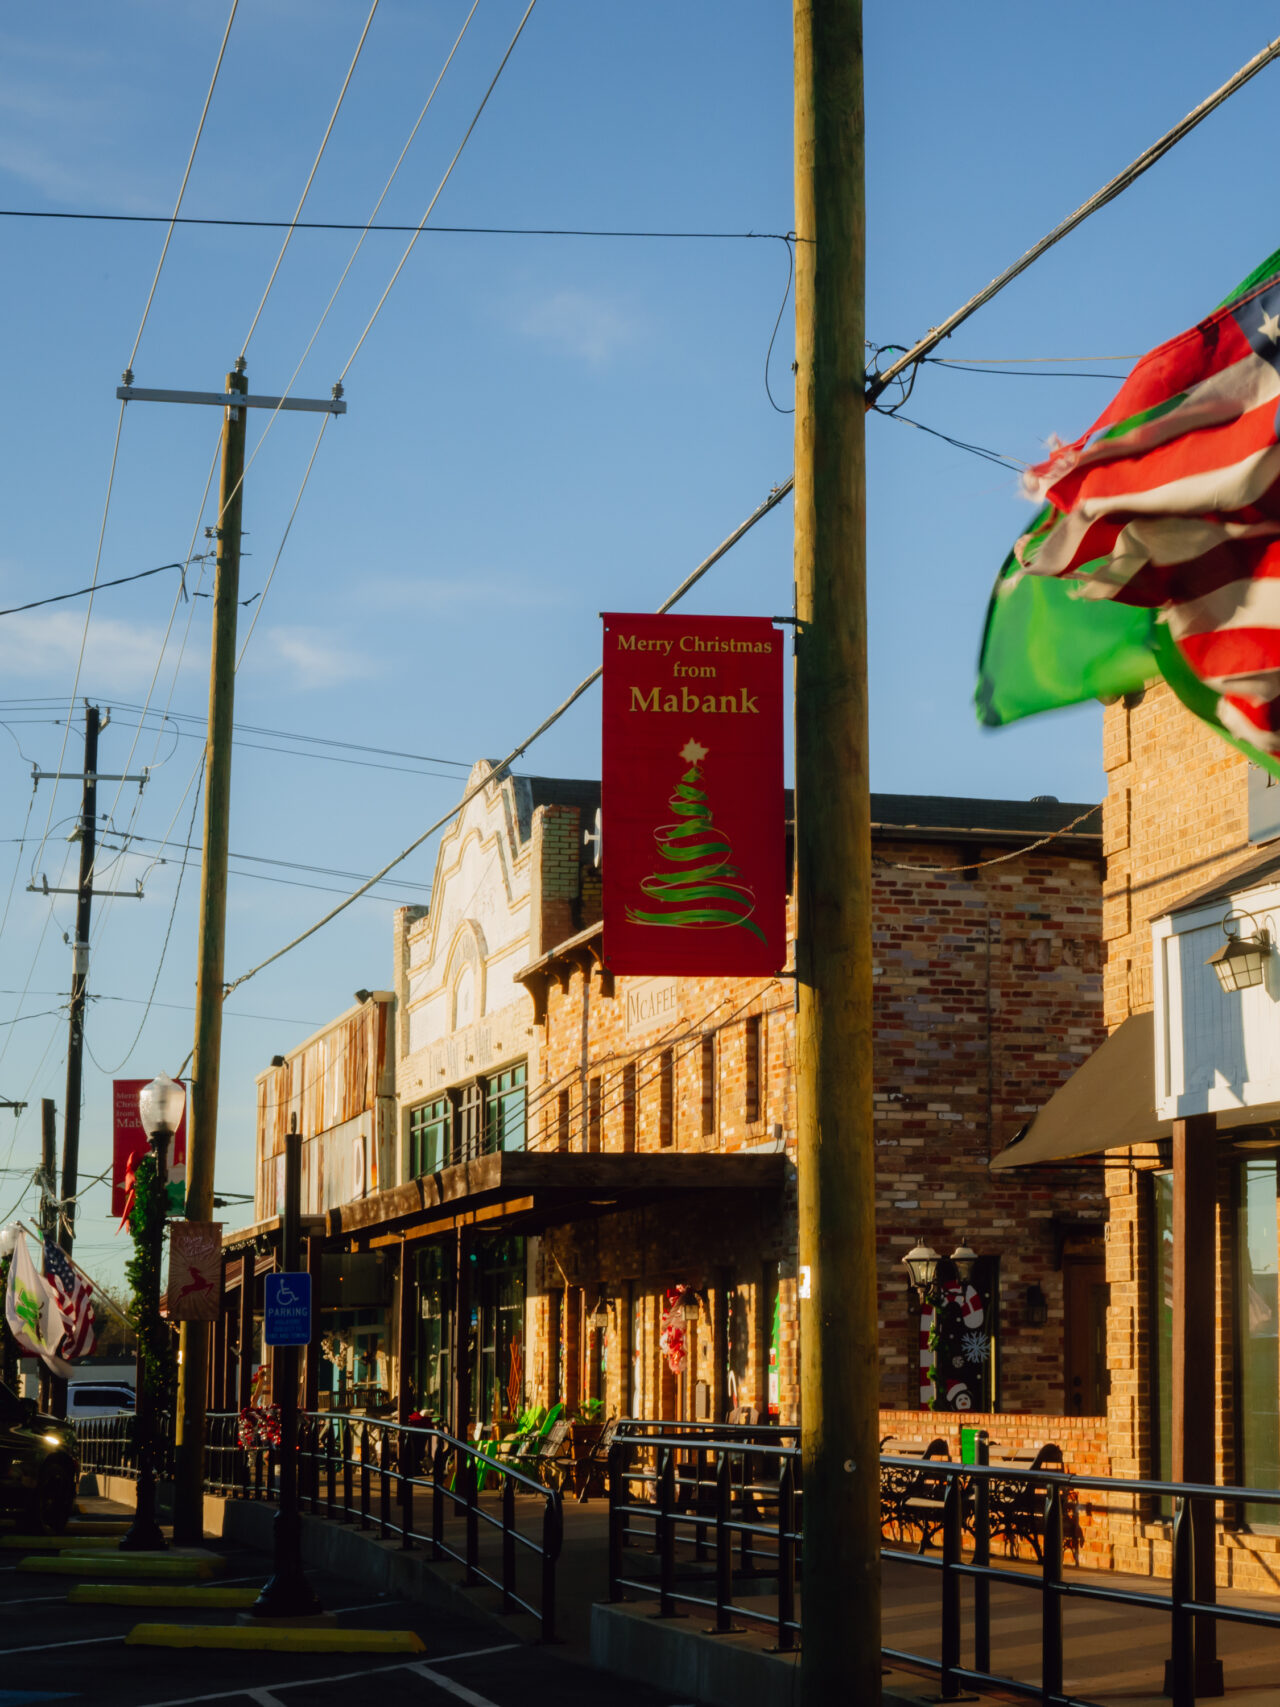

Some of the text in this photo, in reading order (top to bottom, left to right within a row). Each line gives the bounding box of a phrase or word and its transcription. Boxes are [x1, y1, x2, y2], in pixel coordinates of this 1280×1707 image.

[617, 634, 773, 656] Merry Christmas
[673, 662, 717, 678] from
[629, 686, 760, 714] Mabank
[268, 1307, 308, 1317] PARKING
